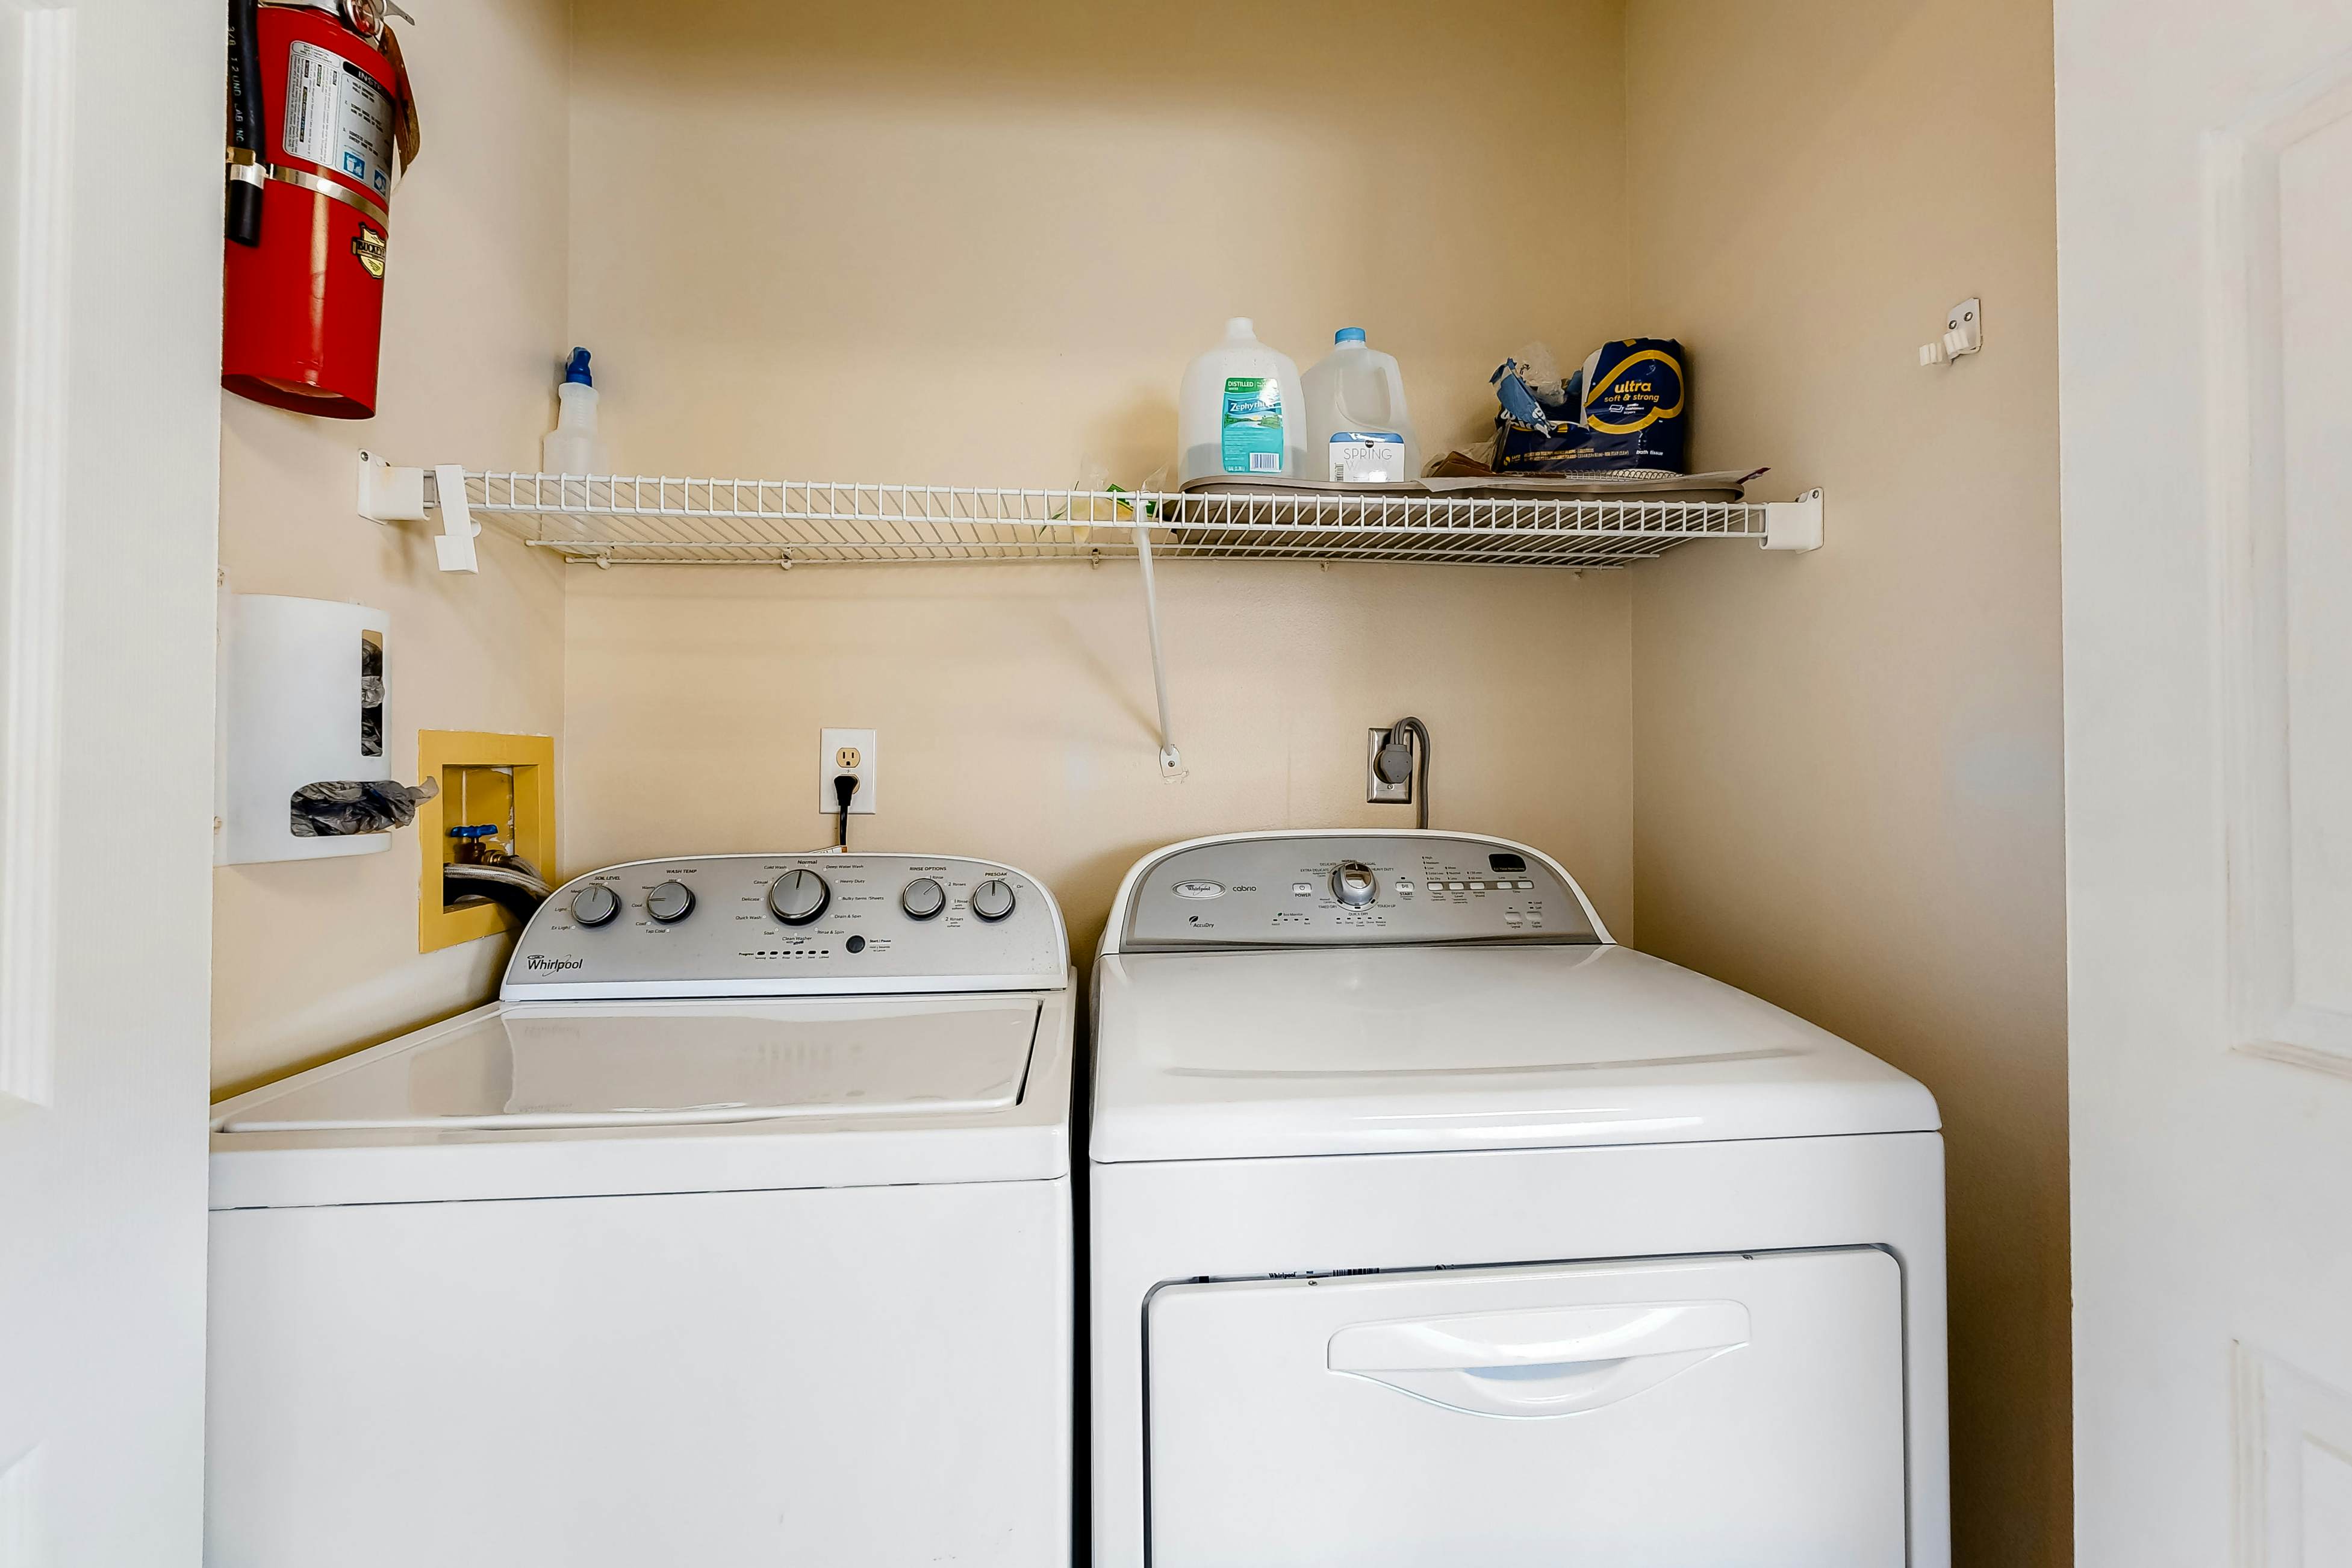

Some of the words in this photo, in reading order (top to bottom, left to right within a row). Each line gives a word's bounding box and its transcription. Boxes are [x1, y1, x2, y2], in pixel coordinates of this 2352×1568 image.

[1614, 380, 1652, 394] ultra
[1632, 393, 1660, 402] strong
[1343, 447, 1392, 460] SPRING
[528, 959, 583, 972] Whirlpool
